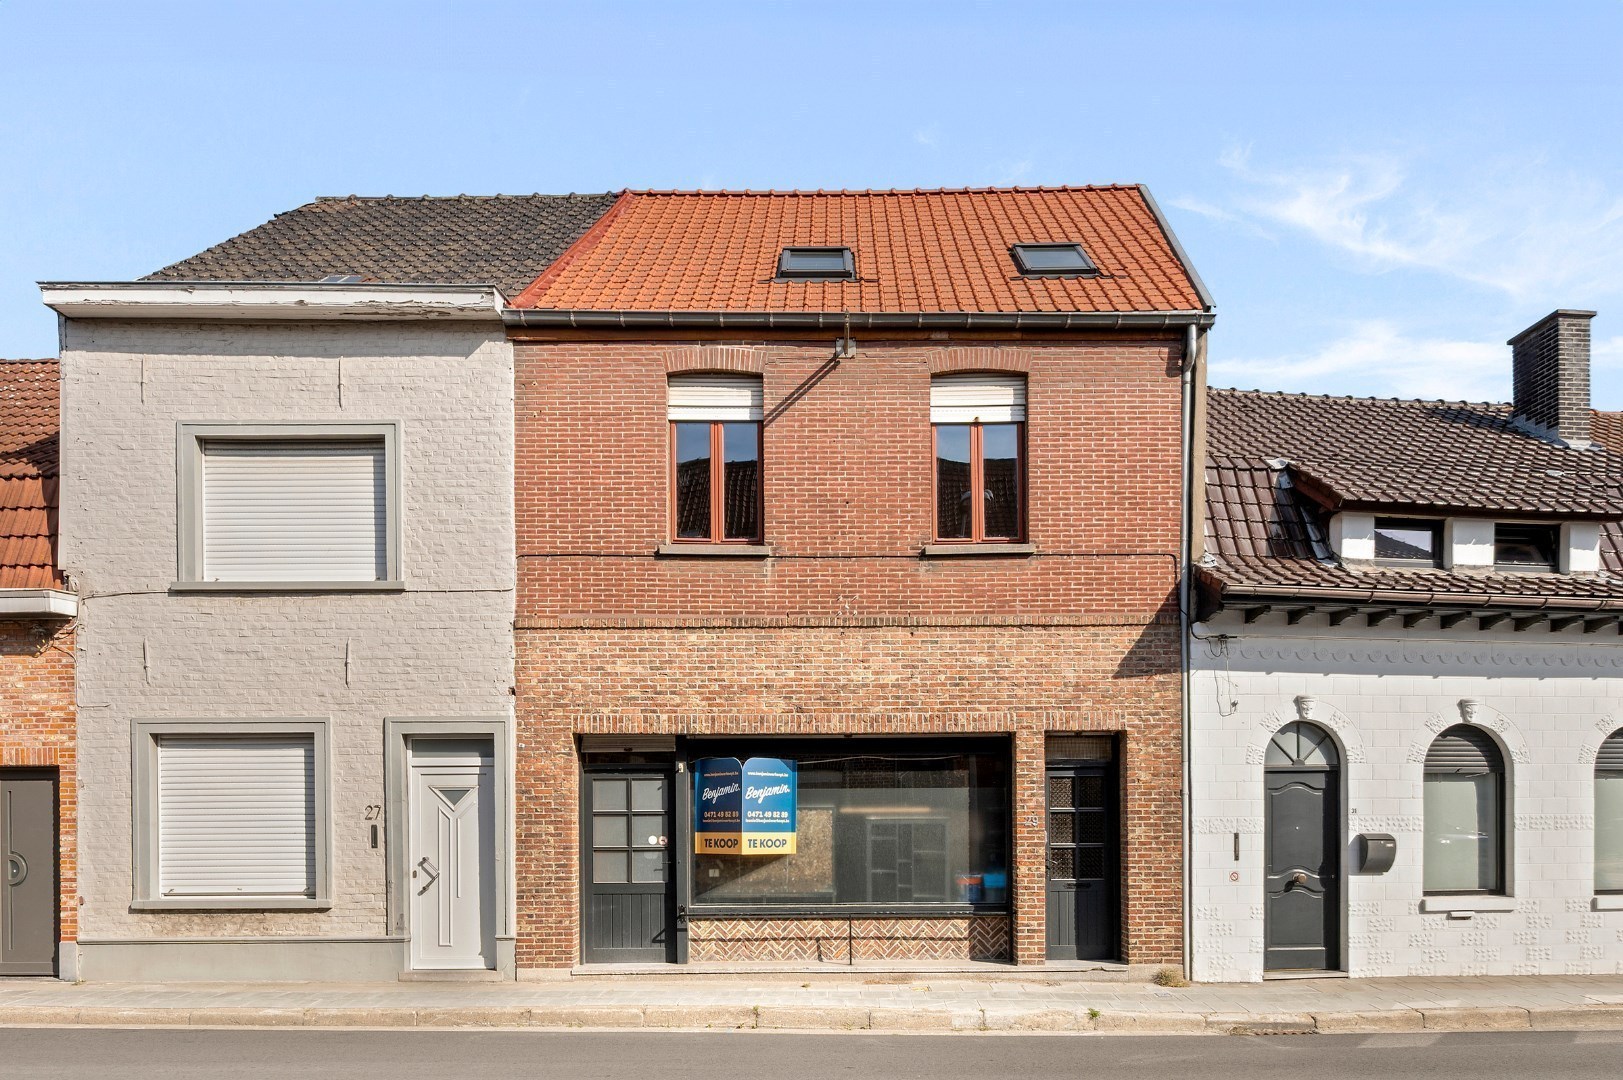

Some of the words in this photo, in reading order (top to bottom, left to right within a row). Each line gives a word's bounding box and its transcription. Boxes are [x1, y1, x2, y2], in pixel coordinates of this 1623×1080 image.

[364, 805, 381, 820] 27
[704, 838, 712, 848] TE
[714, 838, 739, 849] KOOP
[747, 838, 758, 848] TE
[760, 838, 787, 849] KOOP
